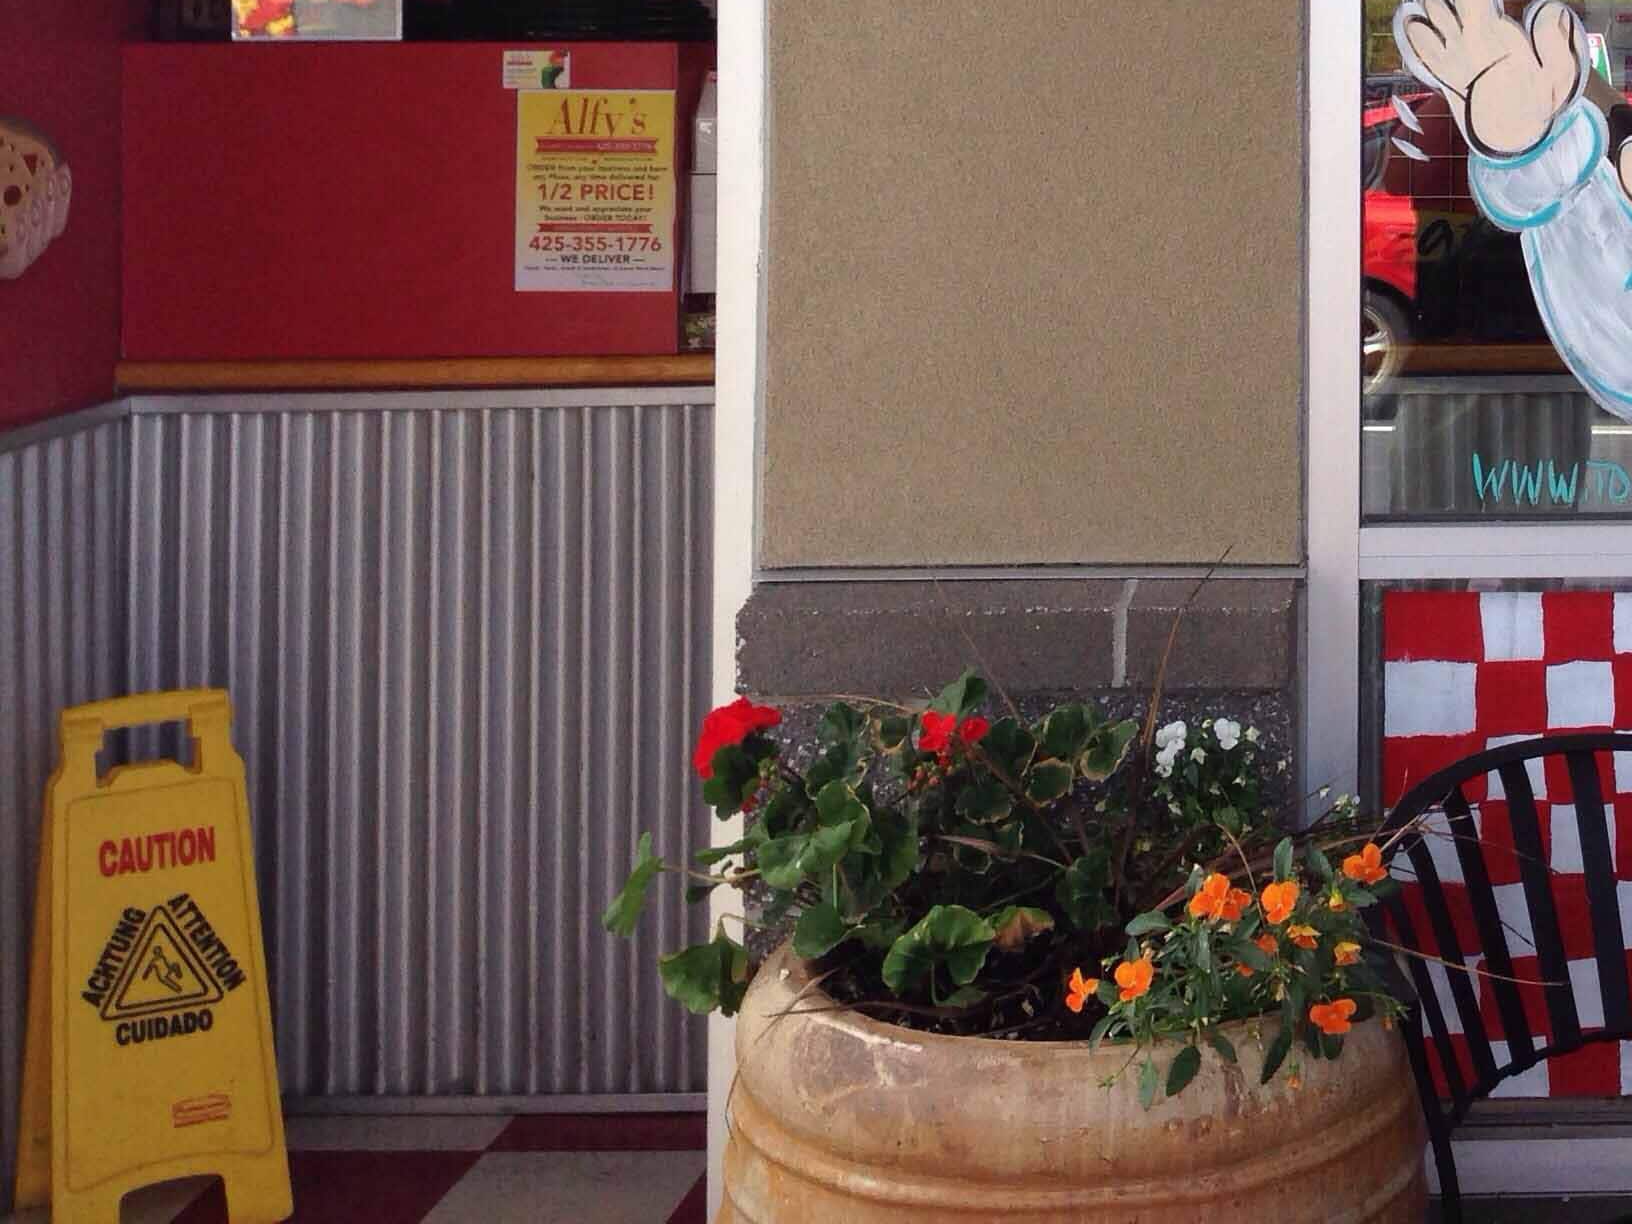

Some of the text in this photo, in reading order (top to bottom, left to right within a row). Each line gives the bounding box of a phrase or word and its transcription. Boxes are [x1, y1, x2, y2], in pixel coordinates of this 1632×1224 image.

[545, 97, 648, 137] Alfy's
[537, 182, 655, 201] 1/2 PRICE!
[529, 235, 662, 253] 425-355-1776
[560, 254, 630, 264] WE DELIVER
[100, 826, 216, 876] CAUTION
[81, 906, 146, 1009] ACHTUNG
[167, 892, 246, 993] ATTENTION
[116, 1009, 213, 1046] CUIDADO
